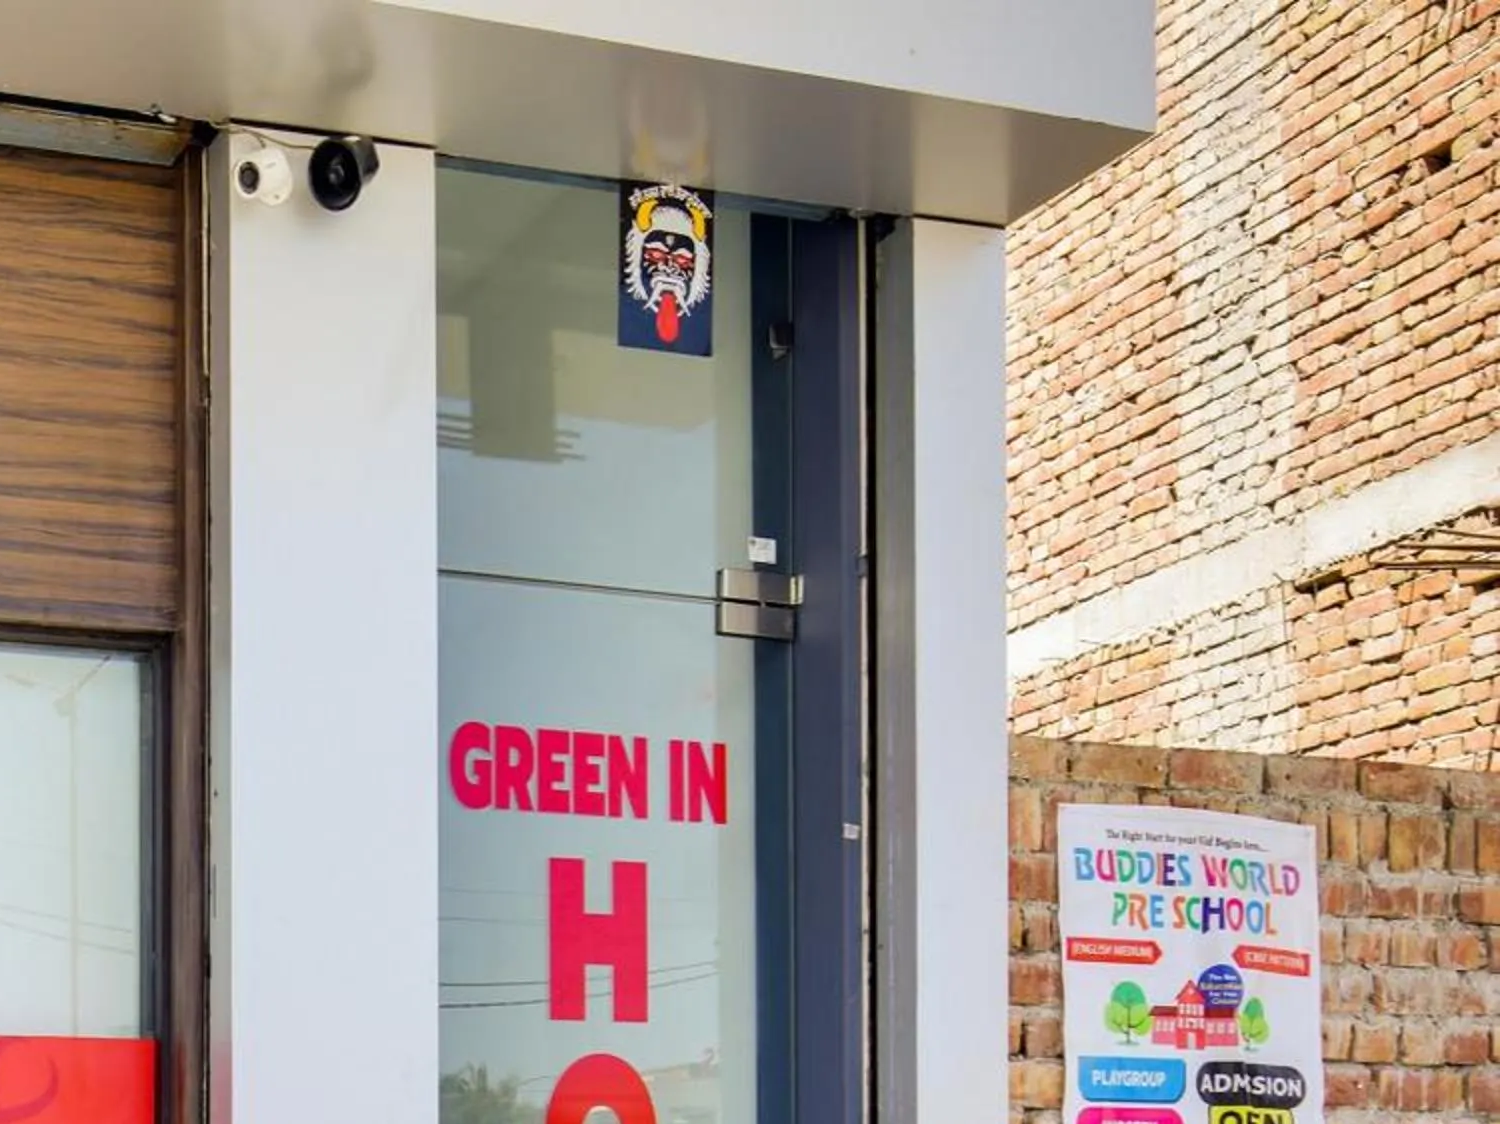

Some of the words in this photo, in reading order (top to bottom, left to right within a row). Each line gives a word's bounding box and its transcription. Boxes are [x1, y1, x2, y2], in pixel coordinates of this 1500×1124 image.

[449, 721, 648, 819] GREEN
[668, 739, 728, 825] IN
[1074, 847, 1192, 886] BUDDIES
[1201, 854, 1300, 896] WORLD
[1112, 892, 1165, 930] PRE
[1171, 894, 1277, 935] SCHOOL
[1092, 1069, 1166, 1088] PLAYGROUP
